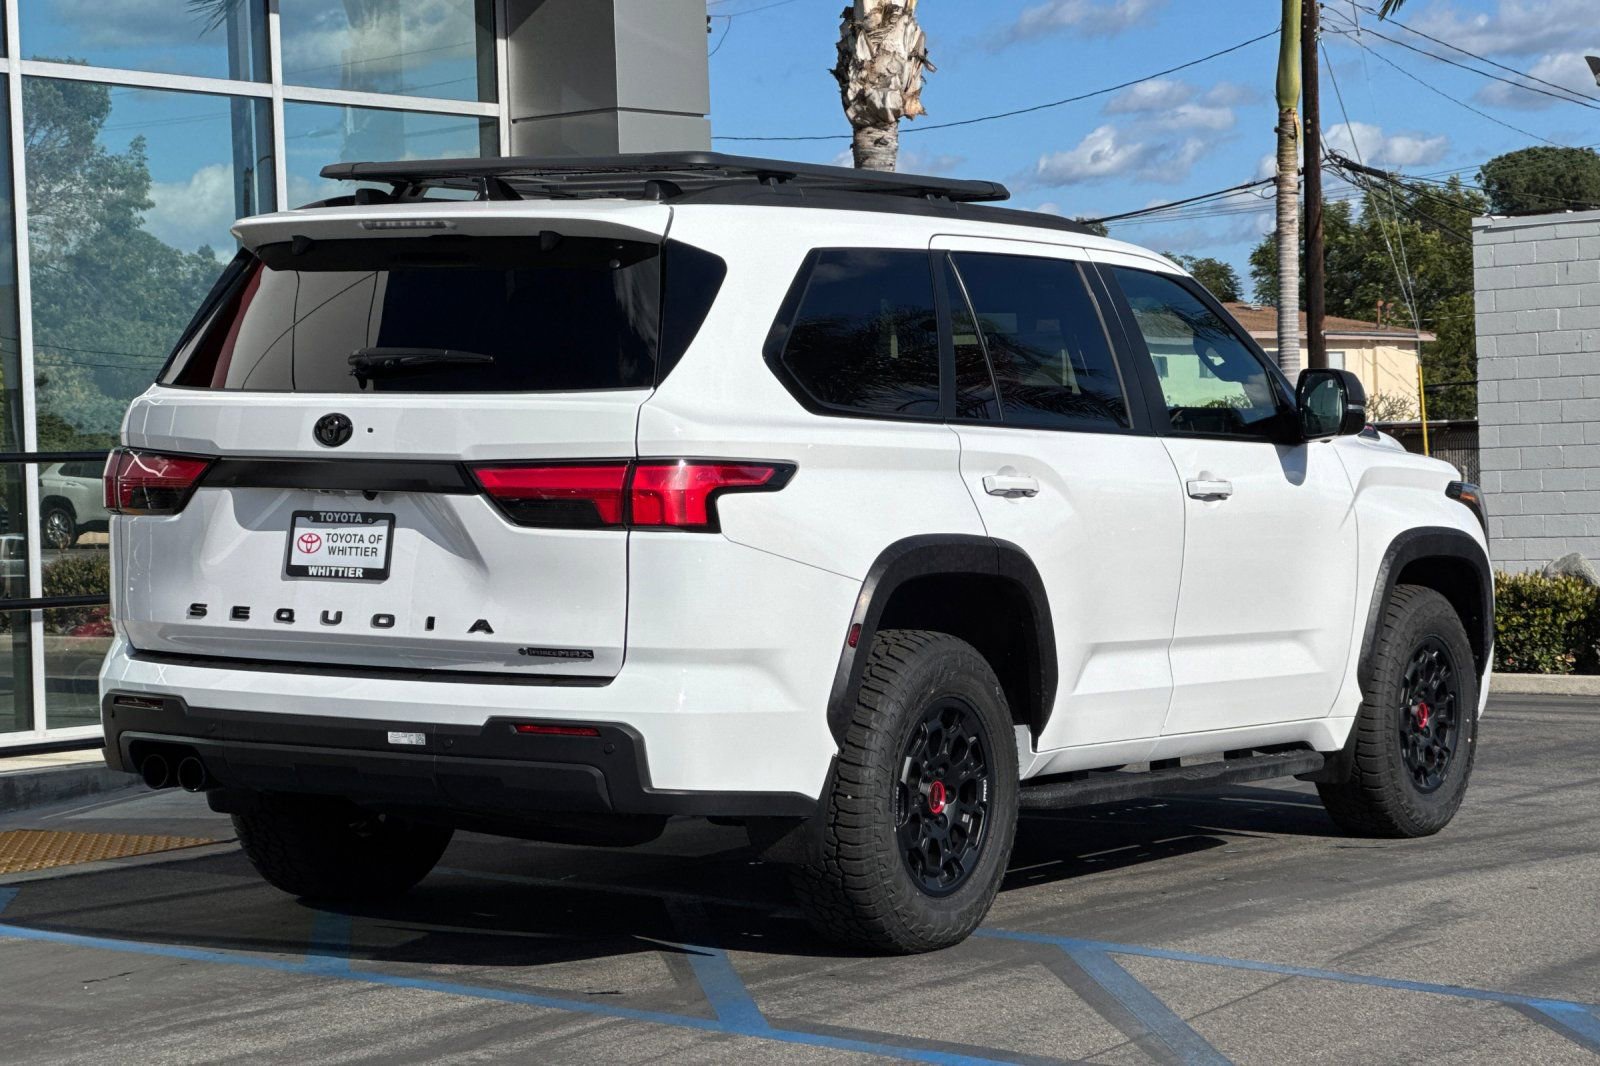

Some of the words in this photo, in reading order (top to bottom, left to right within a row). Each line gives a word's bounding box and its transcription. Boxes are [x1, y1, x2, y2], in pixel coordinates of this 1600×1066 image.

[319, 512, 363, 523] TOYOTA
[325, 533, 365, 544] TOYOTA
[368, 534, 383, 544] OF
[327, 546, 378, 557] WHITTIER
[308, 566, 364, 578] WHITTIER
[189, 602, 495, 634] SEQUOIA
